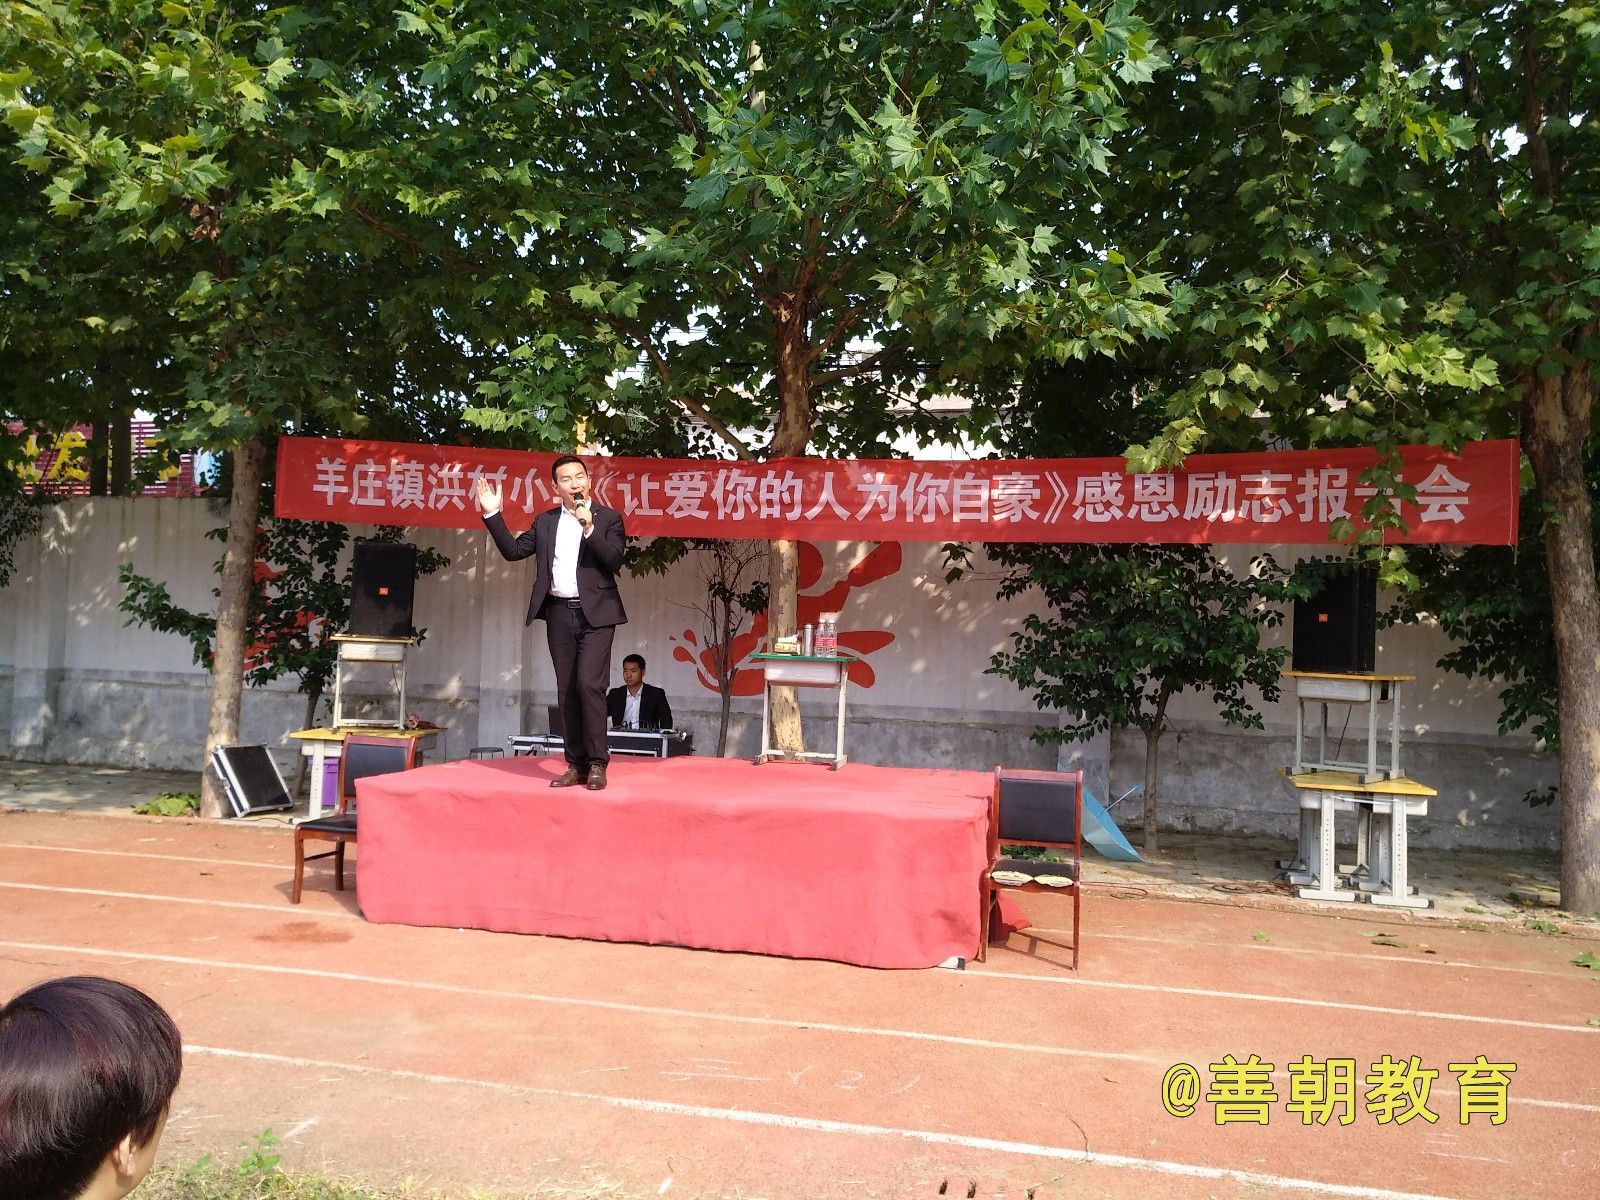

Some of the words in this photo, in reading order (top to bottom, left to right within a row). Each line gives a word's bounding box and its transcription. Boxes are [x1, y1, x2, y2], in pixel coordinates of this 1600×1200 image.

[312, 456, 1470, 525] 羊庄镇洪村小《让爱你的人为你自豪》感恩励志报会
